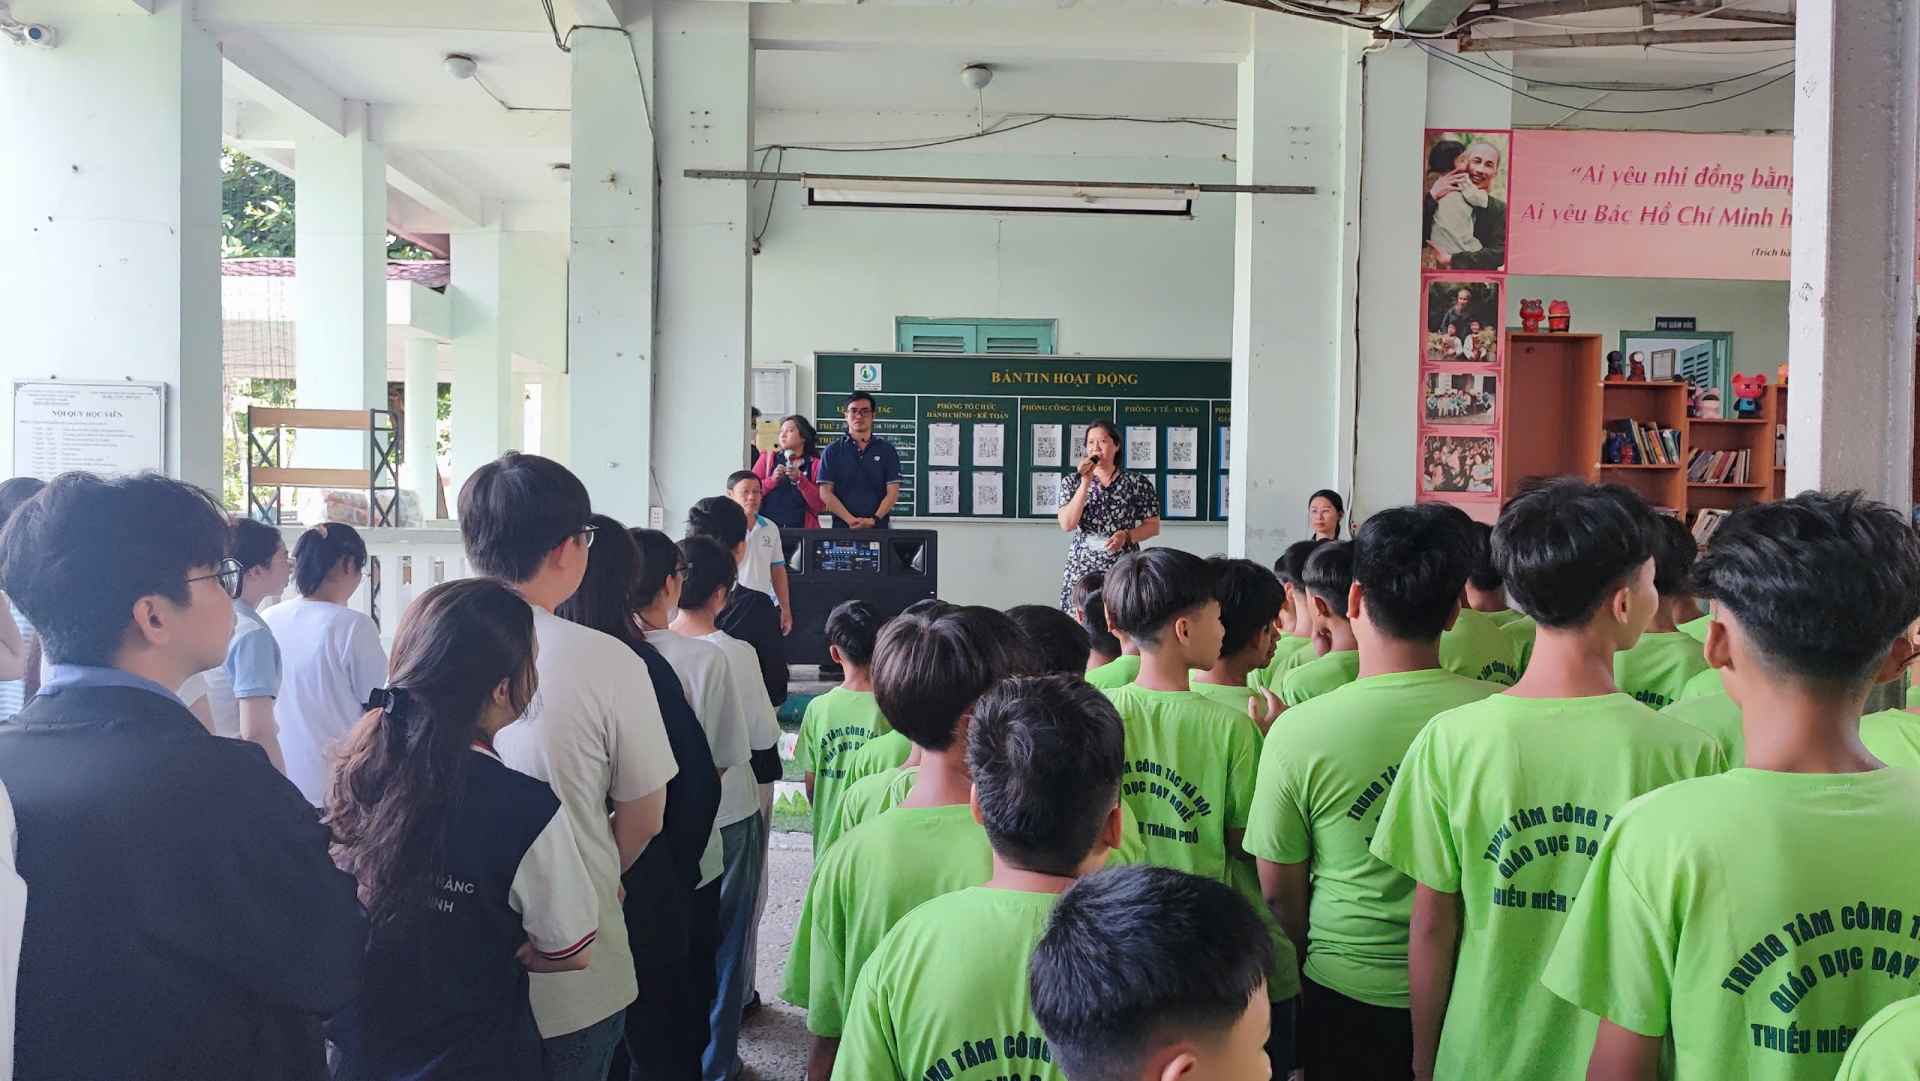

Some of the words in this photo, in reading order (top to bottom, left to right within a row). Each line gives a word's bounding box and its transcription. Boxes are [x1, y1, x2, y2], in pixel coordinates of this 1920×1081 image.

[1610, 166, 1646, 191] yêu
[1653, 166, 1687, 186] nhi
[1694, 163, 1745, 194] đồng
[1520, 203, 1544, 221] Ai
[1550, 203, 1587, 227] yêu
[1594, 203, 1632, 223] Bác
[1640, 202, 1673, 225] Hồ
[1677, 205, 1715, 226] Chí
[1718, 206, 1773, 227] Minh
[991, 369, 1022, 383] BẢN
[1024, 372, 1050, 384] TIN
[1053, 372, 1091, 387] HOẠT
[1096, 371, 1138, 387] ĐỘNG
[1048, 403, 1070, 411] CÔNG
[1071, 404, 1085, 412] TÁC
[1635, 689, 1664, 706] CÔNG
[826, 727, 843, 742] TÂM
[845, 725, 865, 737] CÔNG
[1123, 780, 1146, 796] DỤC
[1150, 781, 1170, 799] DẠY
[1135, 758, 1162, 777] CÔNG
[1165, 767, 1182, 788] TÁC
[1192, 795, 1212, 817] HỘI
[1346, 781, 1385, 821] TRUNG
[1509, 806, 1547, 832] TÂM
[1552, 802, 1598, 827] CÔNG
[1147, 823, 1177, 840] THÀNH
[1178, 826, 1199, 844] PHỐ
[1498, 845, 1534, 879] GIÁO
[1534, 834, 1569, 857] DỤC
[1531, 889, 1567, 912] NIÊN
[1721, 933, 1789, 995] TRUNG
[1782, 908, 1835, 947] TÂM
[1840, 901, 1902, 934] CÔNG
[1769, 964, 1818, 1014] GIÁO
[1818, 946, 1864, 979] DỤC
[1871, 946, 1920, 979] DẠY
[1750, 1021, 1811, 1054] THIẾU
[951, 1037, 998, 1072] TÂM
